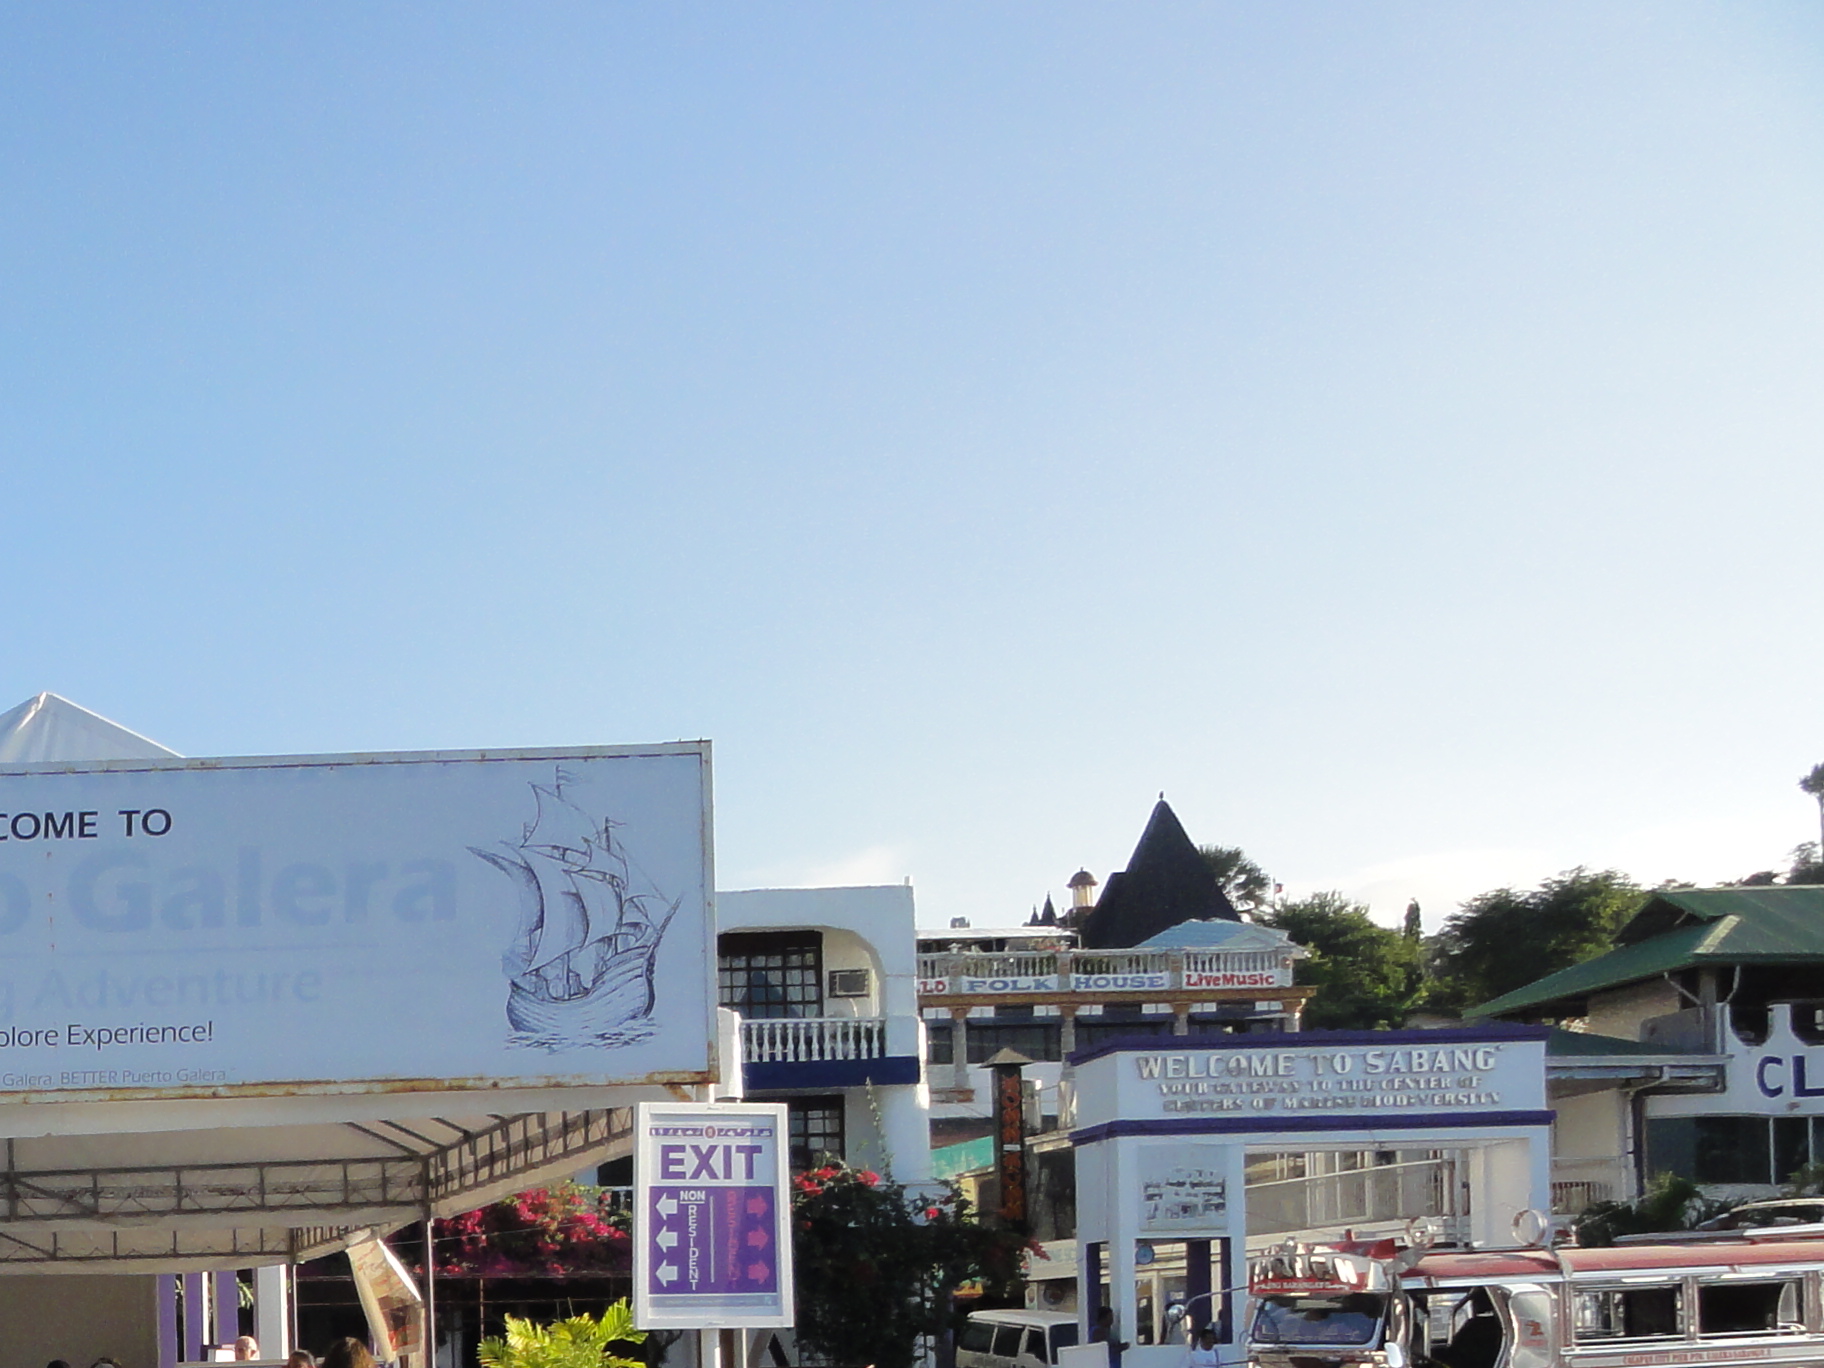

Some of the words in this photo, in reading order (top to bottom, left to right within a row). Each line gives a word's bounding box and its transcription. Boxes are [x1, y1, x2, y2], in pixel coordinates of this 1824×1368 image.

[118, 808, 173, 838] TO
[68, 844, 457, 933] Galera
[35, 964, 323, 1008] Adventure
[965, 978, 1054, 992] FOLK
[1073, 975, 1165, 990] HOUSE
[67, 1020, 214, 1051] Experience!
[60, 1071, 118, 1085] BETTER
[122, 1070, 173, 1084] Puerto
[1137, 1053, 1296, 1080] WELCOME
[1309, 1052, 1353, 1075] TO
[1363, 1047, 1496, 1074] SABANG
[660, 1144, 763, 1180] EXIT
[680, 1190, 706, 1201] NON
[688, 1204, 700, 1290] RESIDENT
